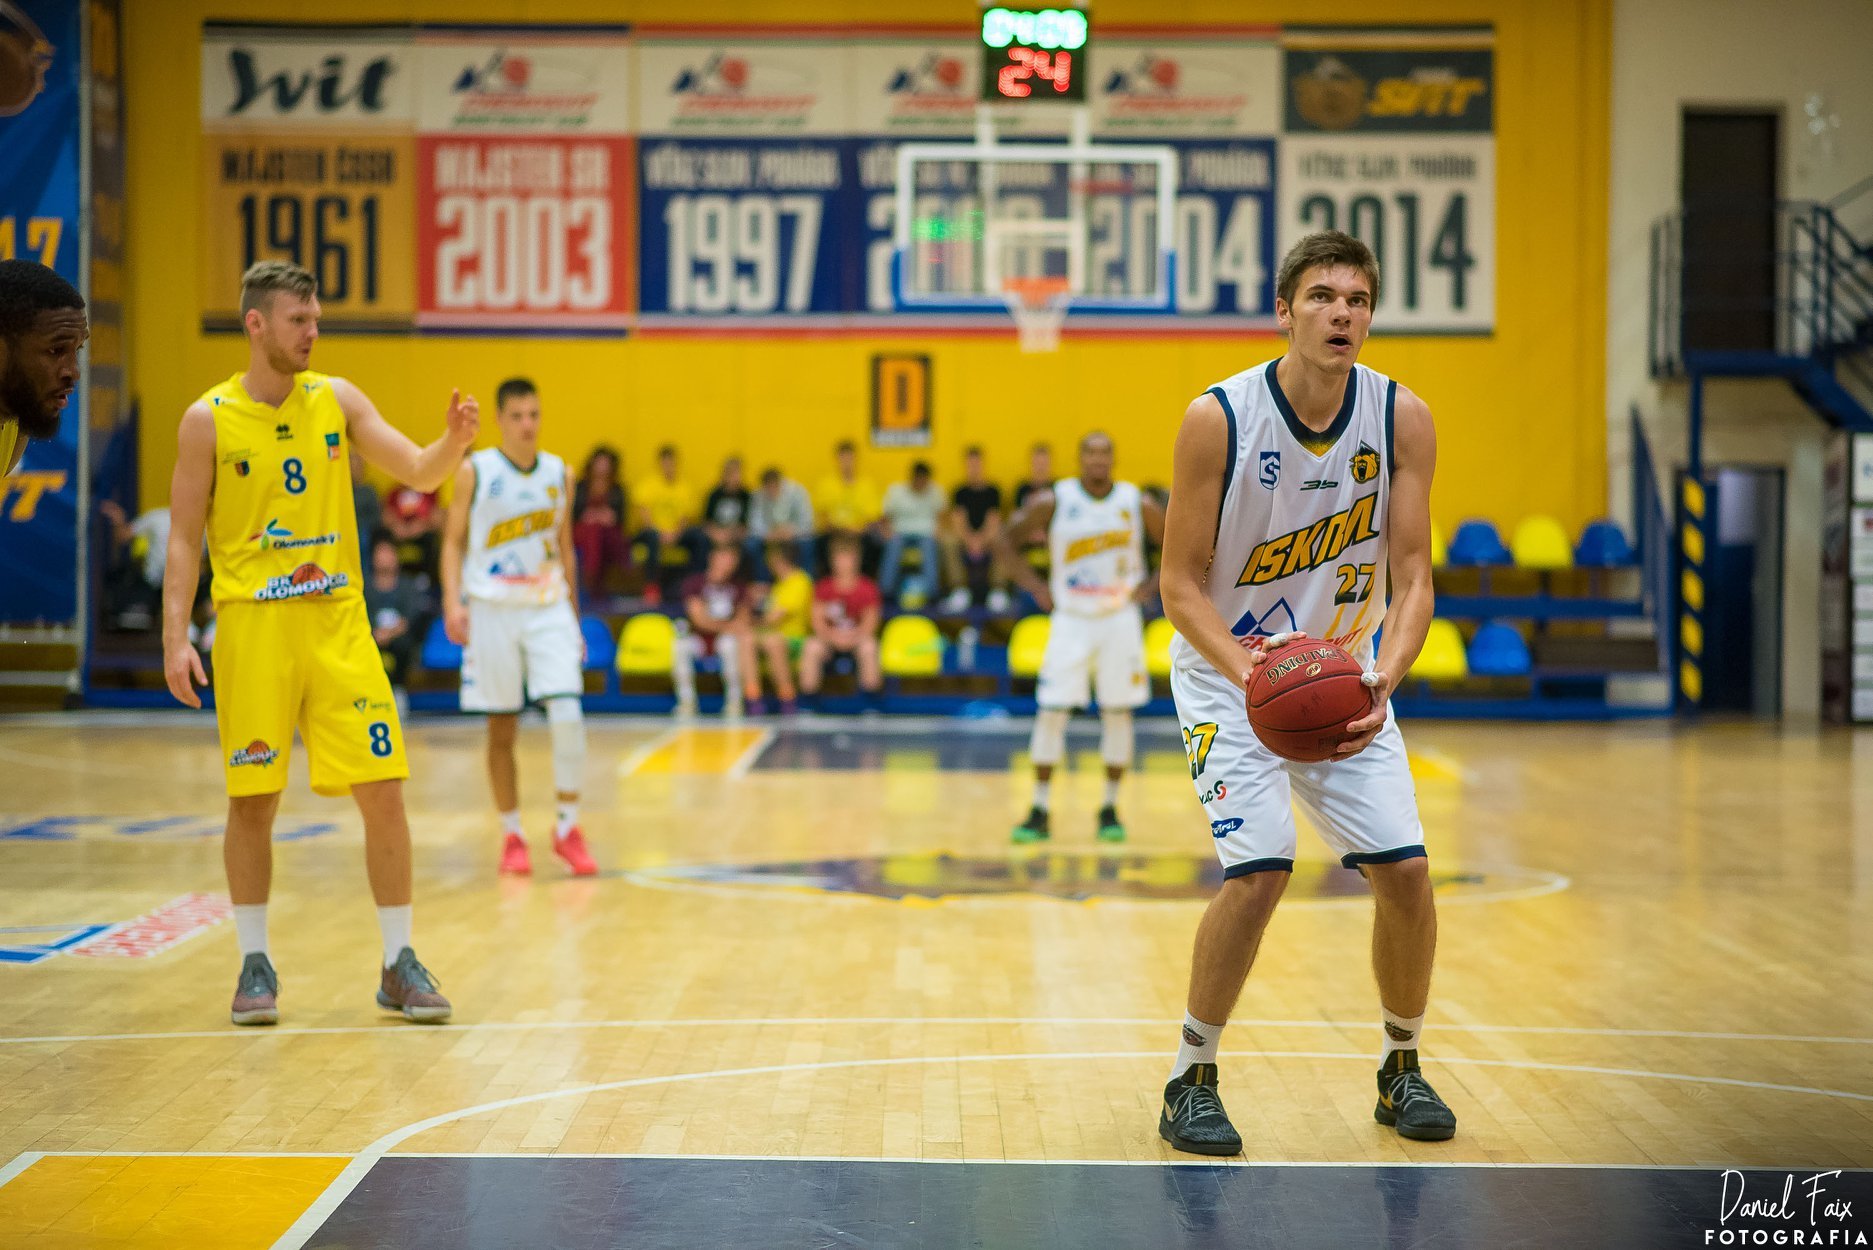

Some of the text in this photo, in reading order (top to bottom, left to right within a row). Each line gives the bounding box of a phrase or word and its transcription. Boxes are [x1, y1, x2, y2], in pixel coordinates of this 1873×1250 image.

[998, 47, 1071, 97] 24
[239, 196, 378, 303] 1961
[436, 198, 612, 308] 2003
[665, 195, 823, 312] 1997
[283, 458, 307, 494] 8
[1234, 491, 1380, 589] ISKRA
[1334, 562, 1377, 606] 27
[368, 722, 393, 757] 8
